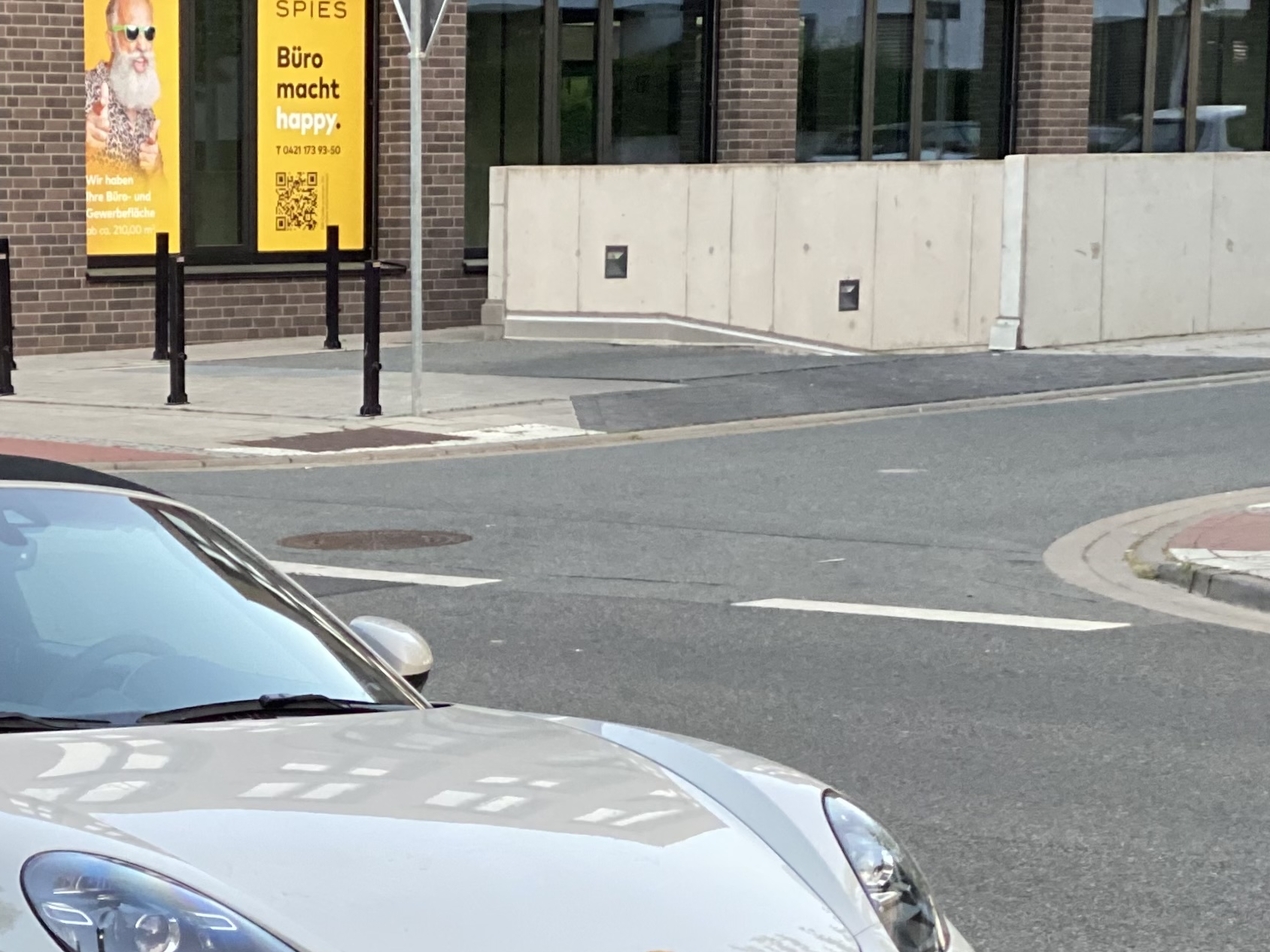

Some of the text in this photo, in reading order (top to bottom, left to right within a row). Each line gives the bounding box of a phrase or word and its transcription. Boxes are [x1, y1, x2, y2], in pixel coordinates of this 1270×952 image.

[276, 0, 347, 18] SPIES
[277, 46, 323, 68] Büro
[277, 76, 340, 99] macht
[276, 105, 341, 135] happy.
[276, 145, 341, 155] T 0421 173 93-50
[86, 174, 134, 185] Wir haben
[86, 190, 151, 202] Ihre Büro- und
[86, 207, 155, 218] Gewerbefläche
